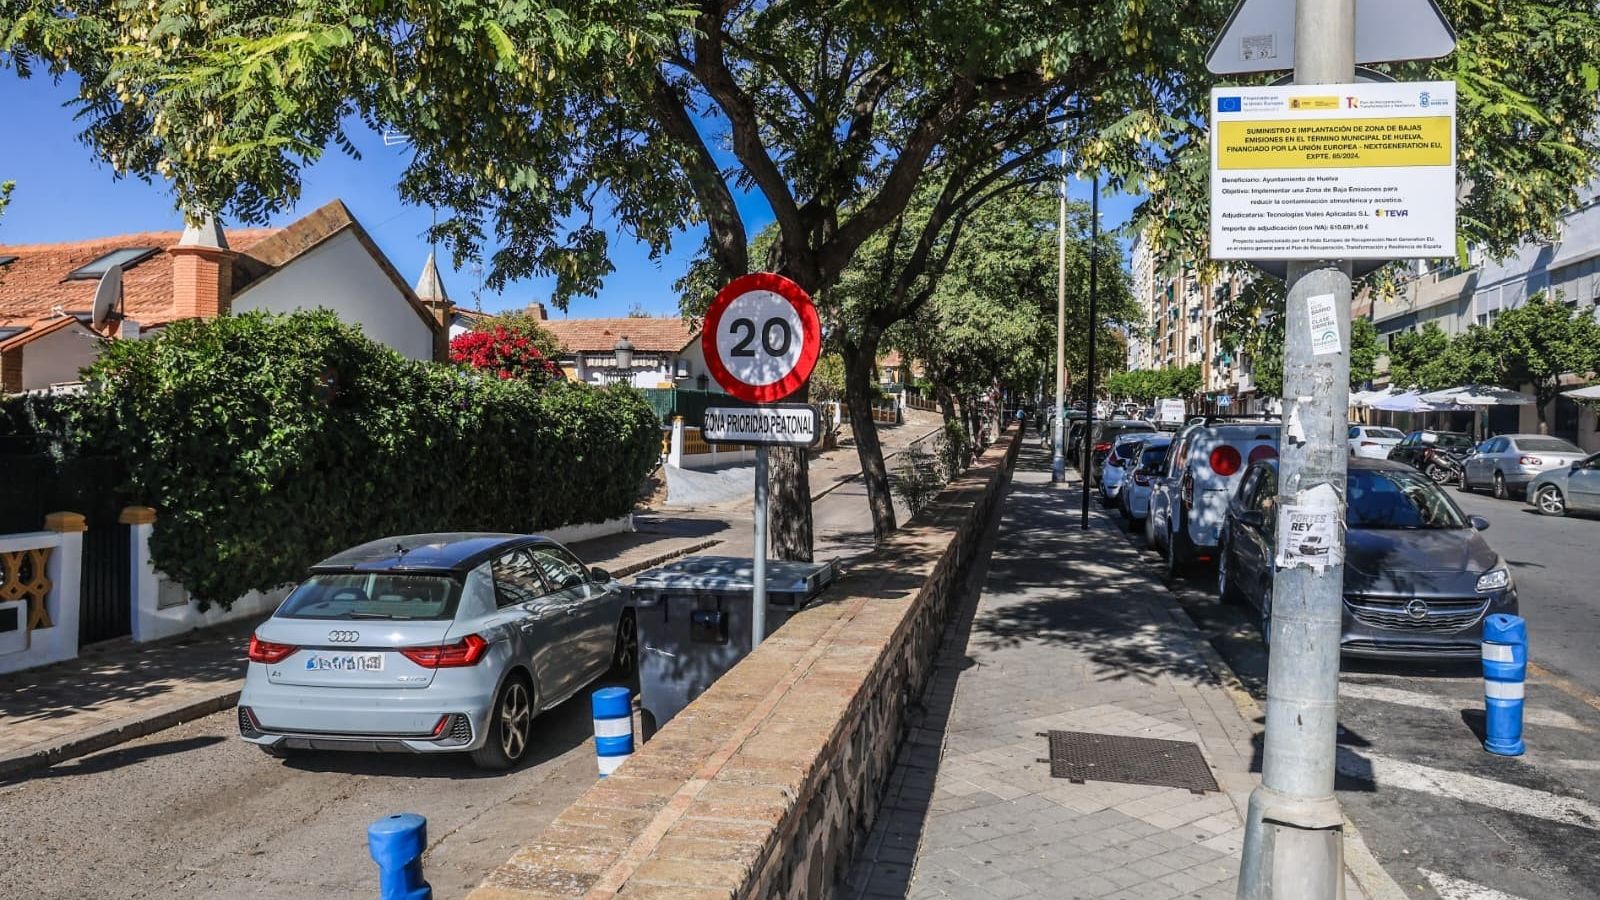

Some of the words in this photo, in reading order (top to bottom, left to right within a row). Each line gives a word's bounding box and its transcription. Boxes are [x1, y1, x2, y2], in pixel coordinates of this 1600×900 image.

[730, 317, 792, 357] 20
[705, 414, 725, 432] ZONA
[727, 415, 768, 433] PRIORIDAD
[770, 416, 812, 434] PEATONAL
[1290, 514, 1327, 523] PORTES
[1291, 523, 1313, 531] REY
